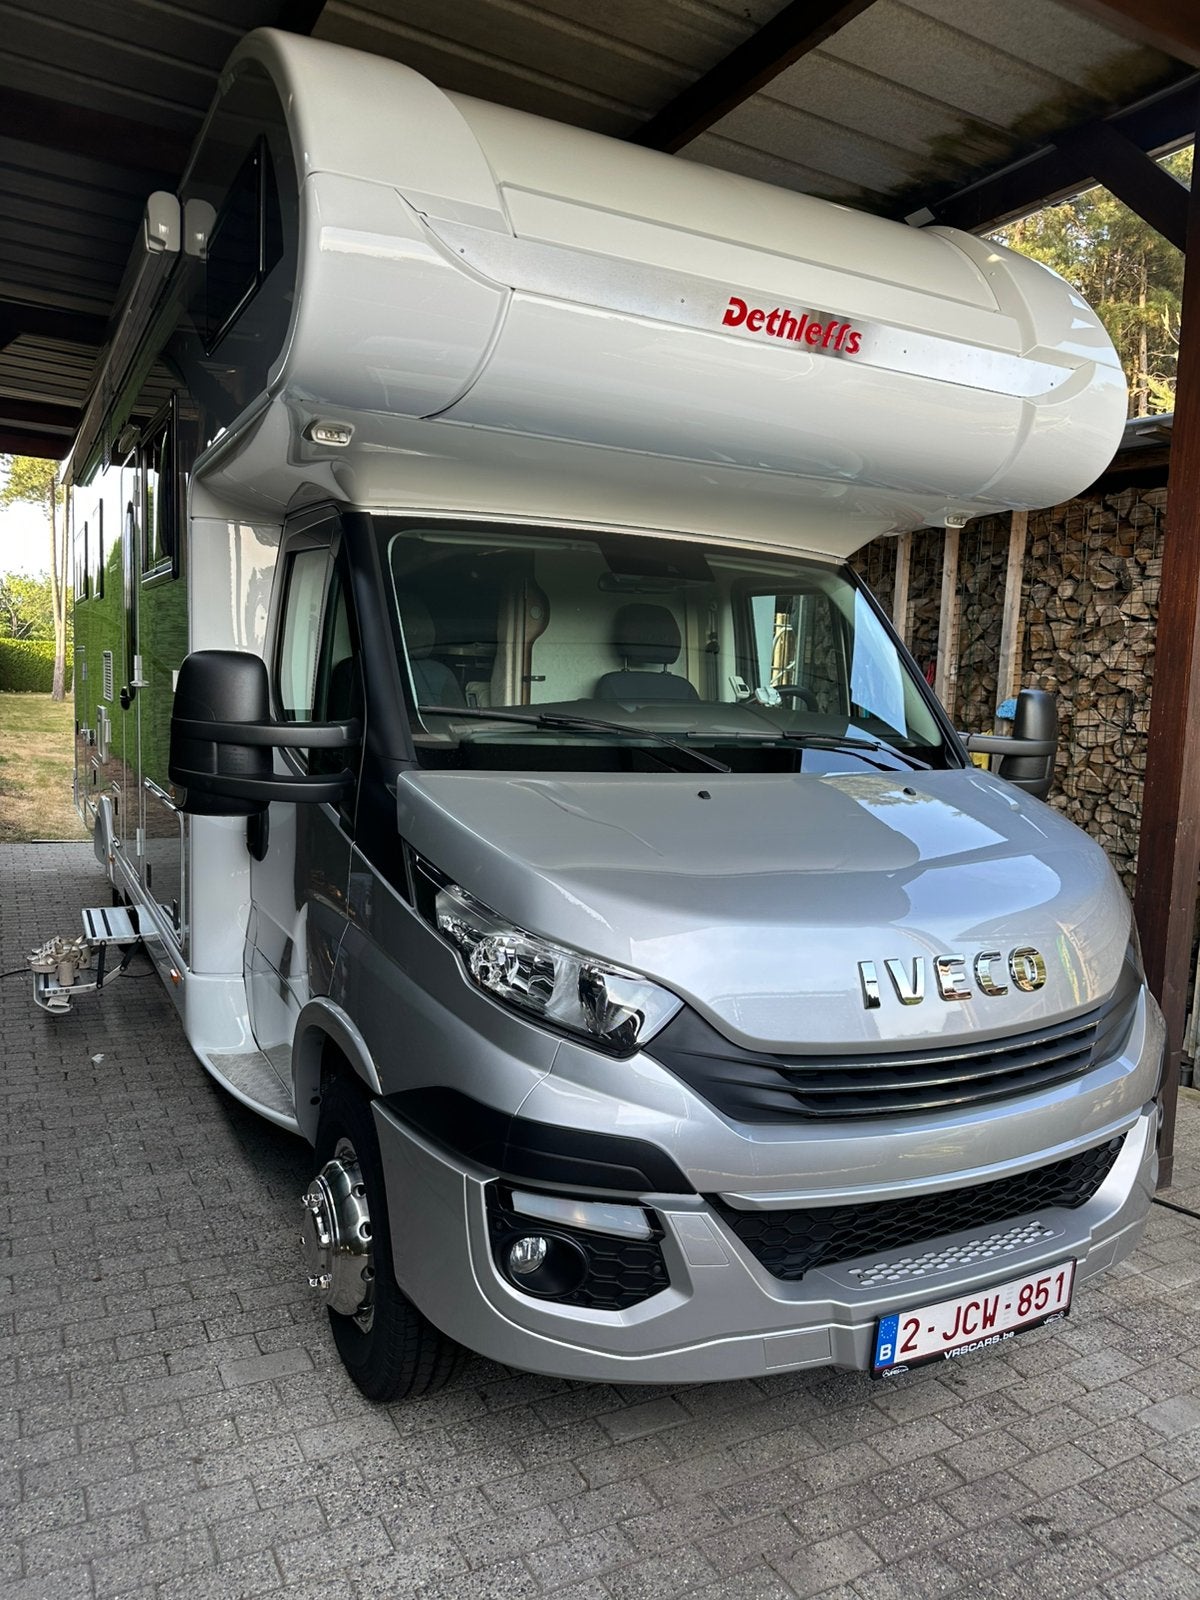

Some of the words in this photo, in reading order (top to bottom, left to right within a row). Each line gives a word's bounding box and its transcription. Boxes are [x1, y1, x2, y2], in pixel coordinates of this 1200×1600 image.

[722, 296, 862, 354] Dethleffs
[857, 945, 1047, 1009] IVECO
[900, 1271, 1065, 1354] 2-JCW-851
[879, 1343, 892, 1361] B
[943, 1331, 1015, 1360] VRSCARS.be
